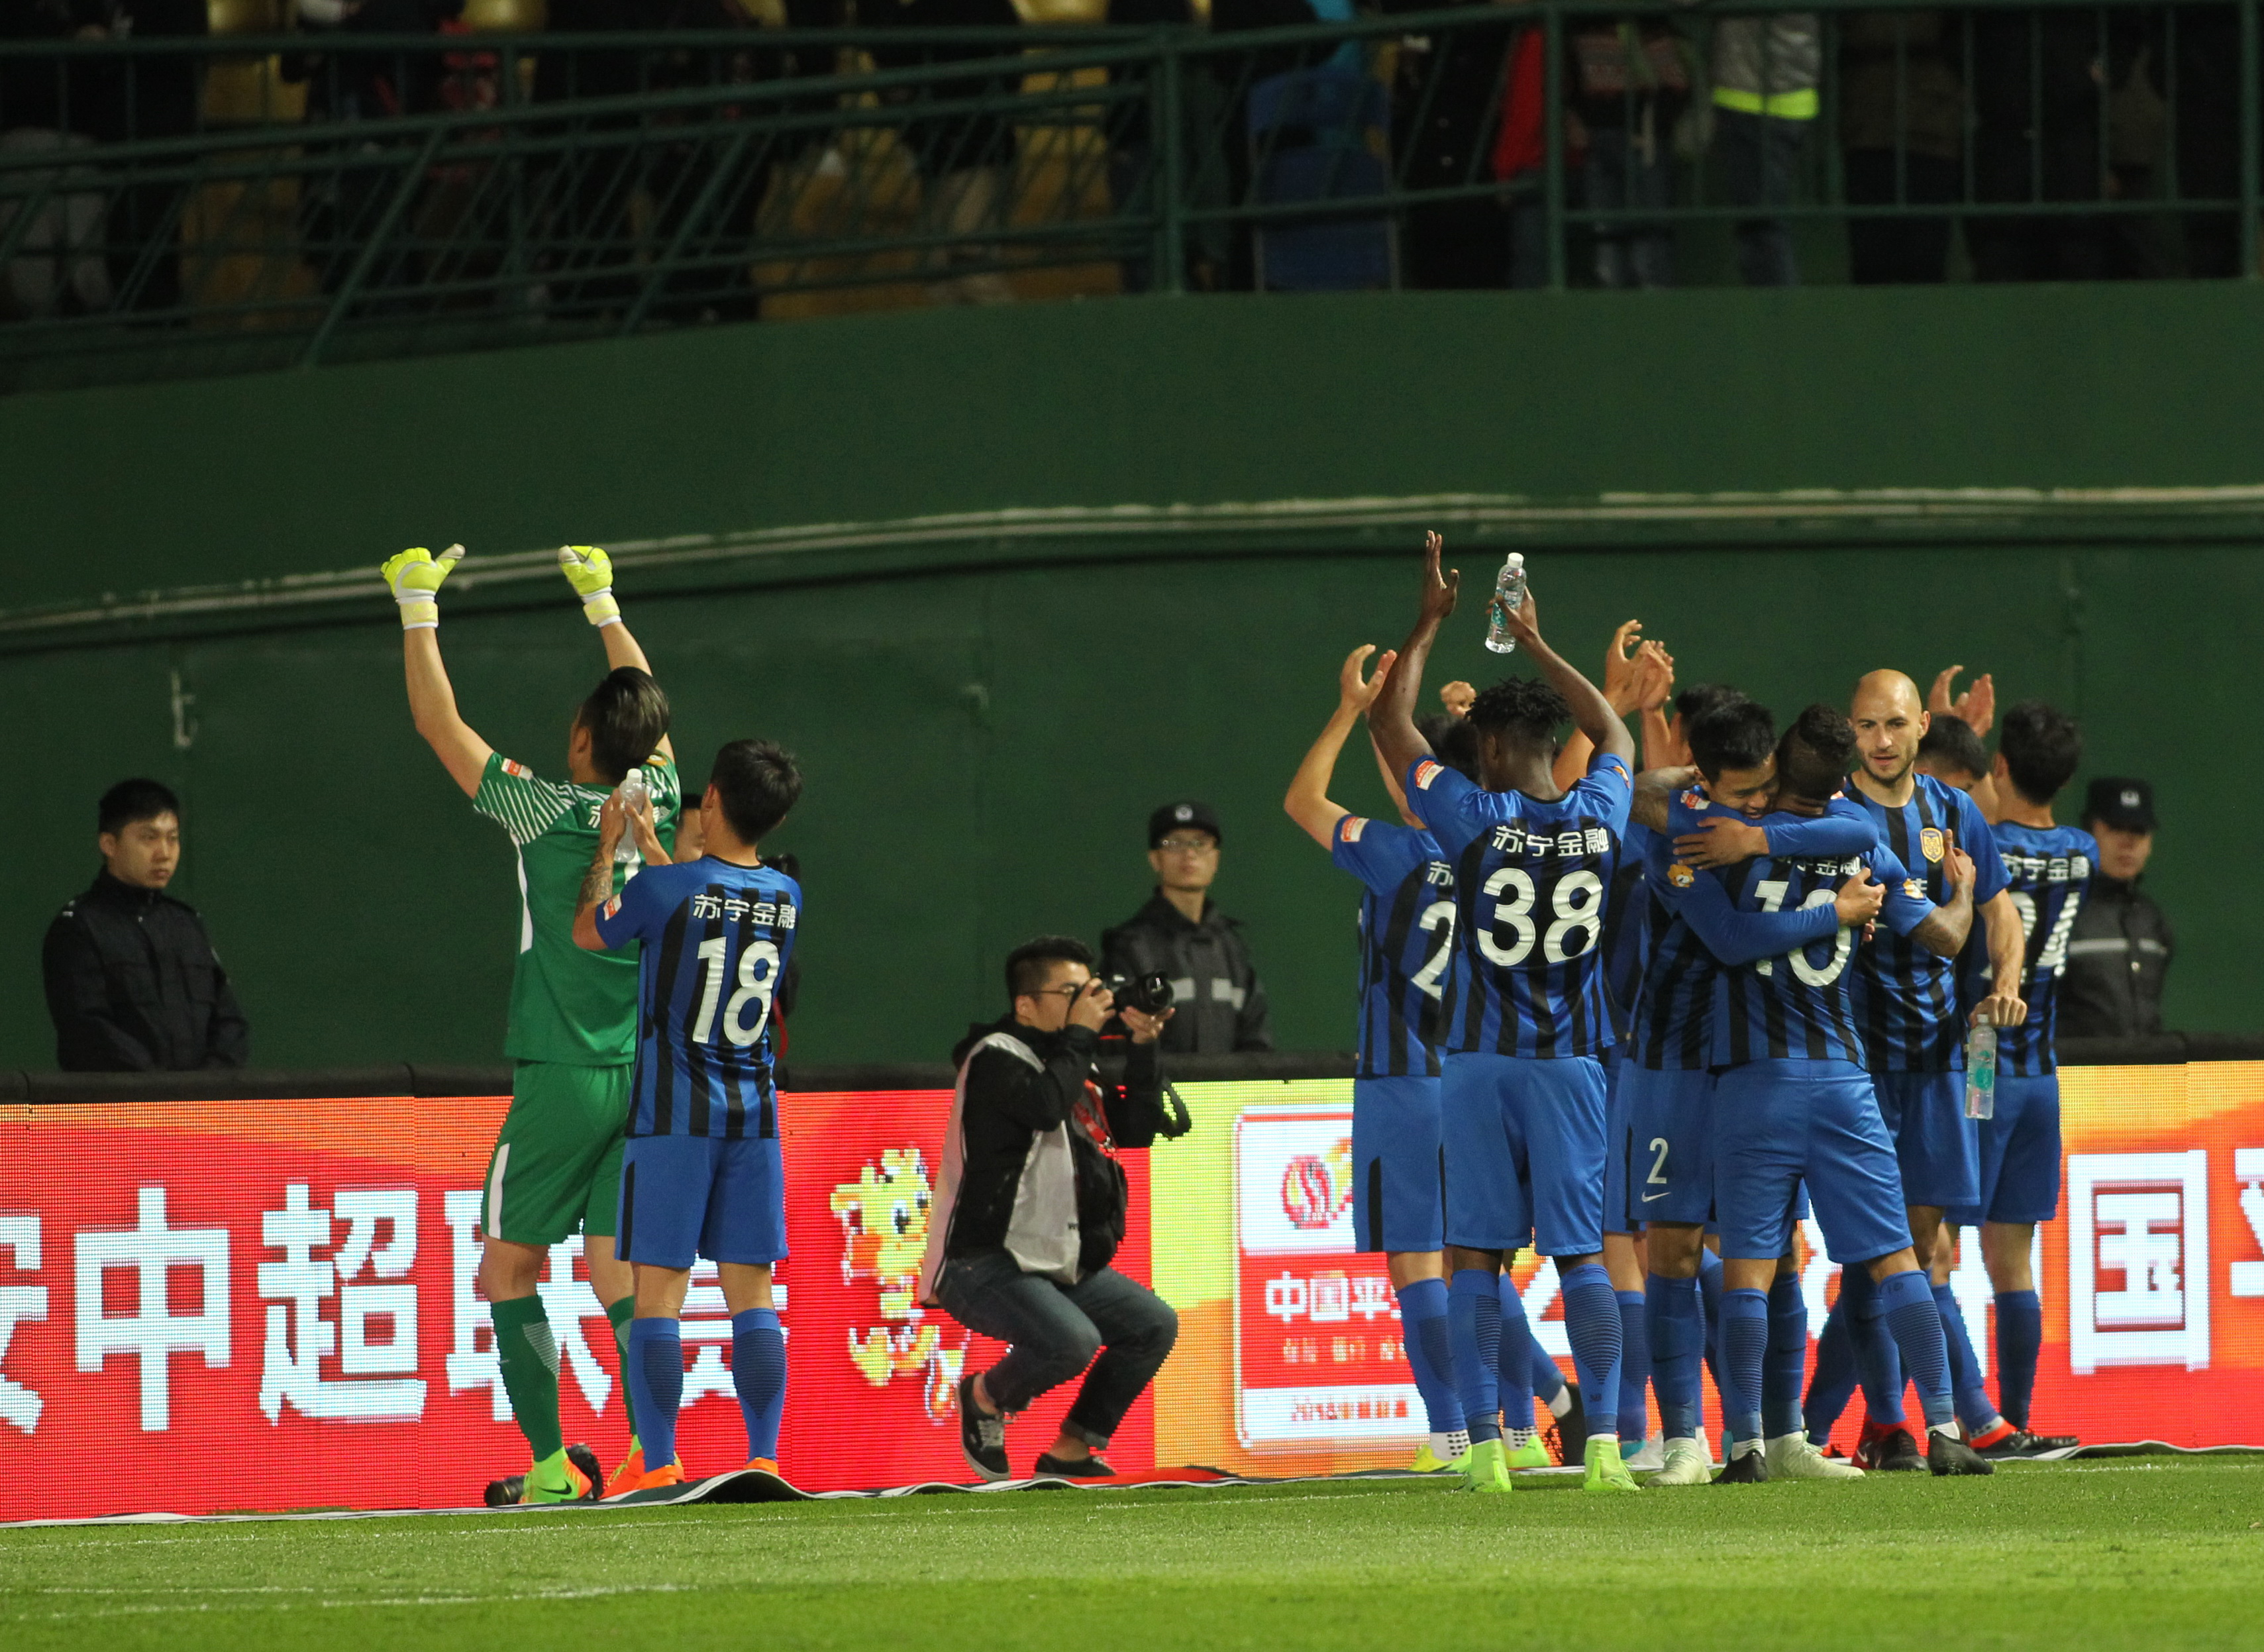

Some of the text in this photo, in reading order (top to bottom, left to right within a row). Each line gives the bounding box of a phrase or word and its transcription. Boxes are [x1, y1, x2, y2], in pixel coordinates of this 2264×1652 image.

[1492, 825, 1610, 857] 苏宁金融
[694, 894, 796, 929] 苏宁金融
[1477, 868, 1603, 966] 38
[692, 936, 780, 1046] 18
[1646, 1137, 1669, 1184] 2
[1265, 1270, 1402, 1323] 中国平
